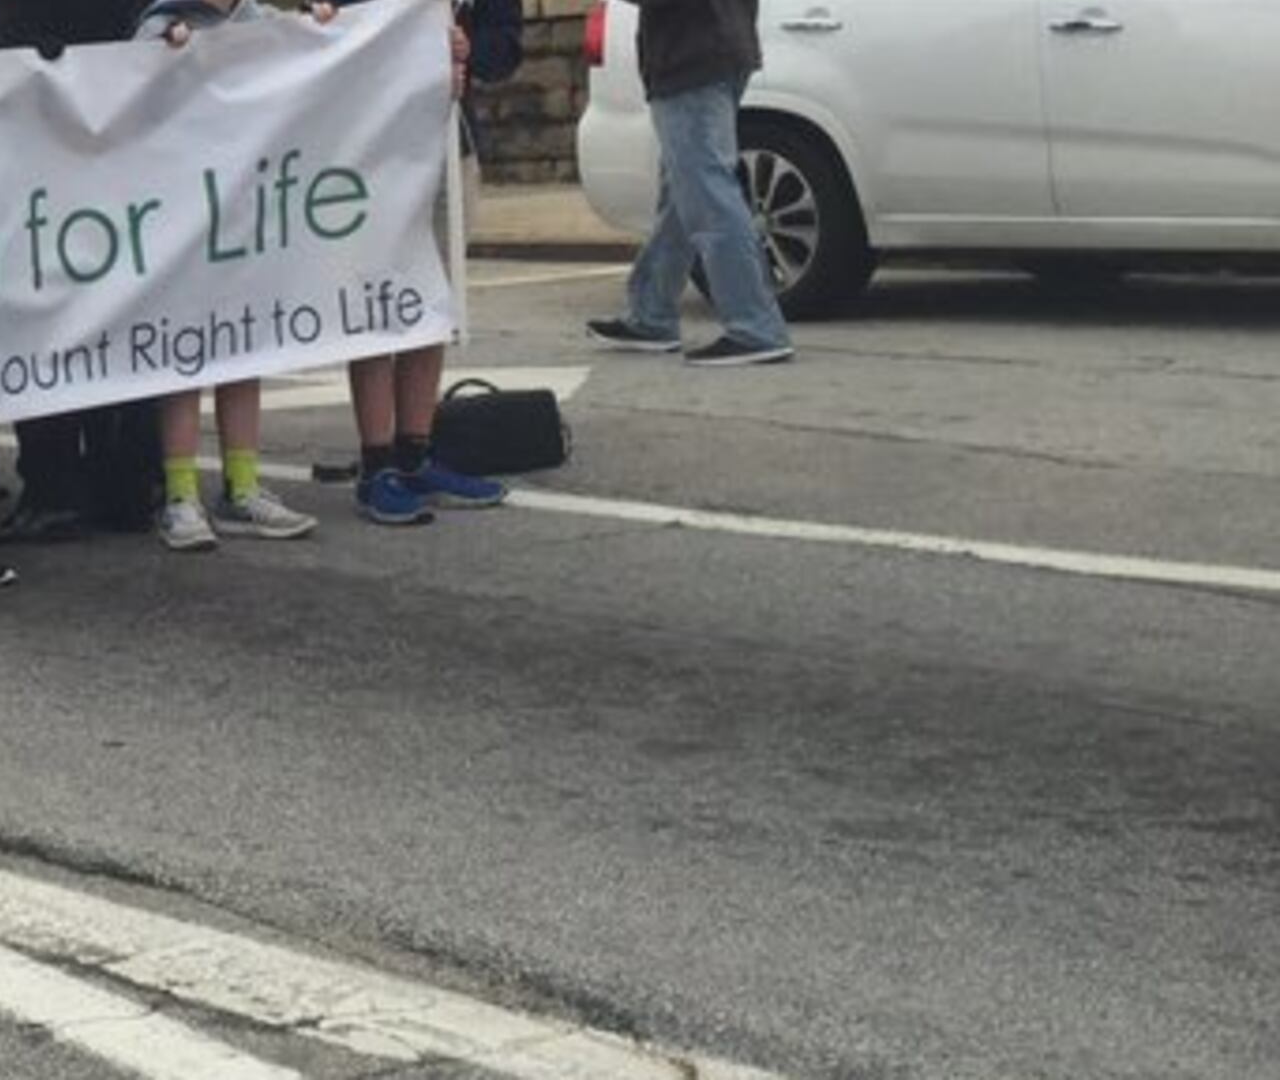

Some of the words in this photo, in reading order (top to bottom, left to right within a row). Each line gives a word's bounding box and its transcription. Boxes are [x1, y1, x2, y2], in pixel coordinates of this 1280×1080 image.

[24, 188, 162, 291] for
[202, 148, 369, 263] Life
[128, 304, 257, 376] Right
[271, 299, 322, 347] to
[338, 279, 424, 336] Life
